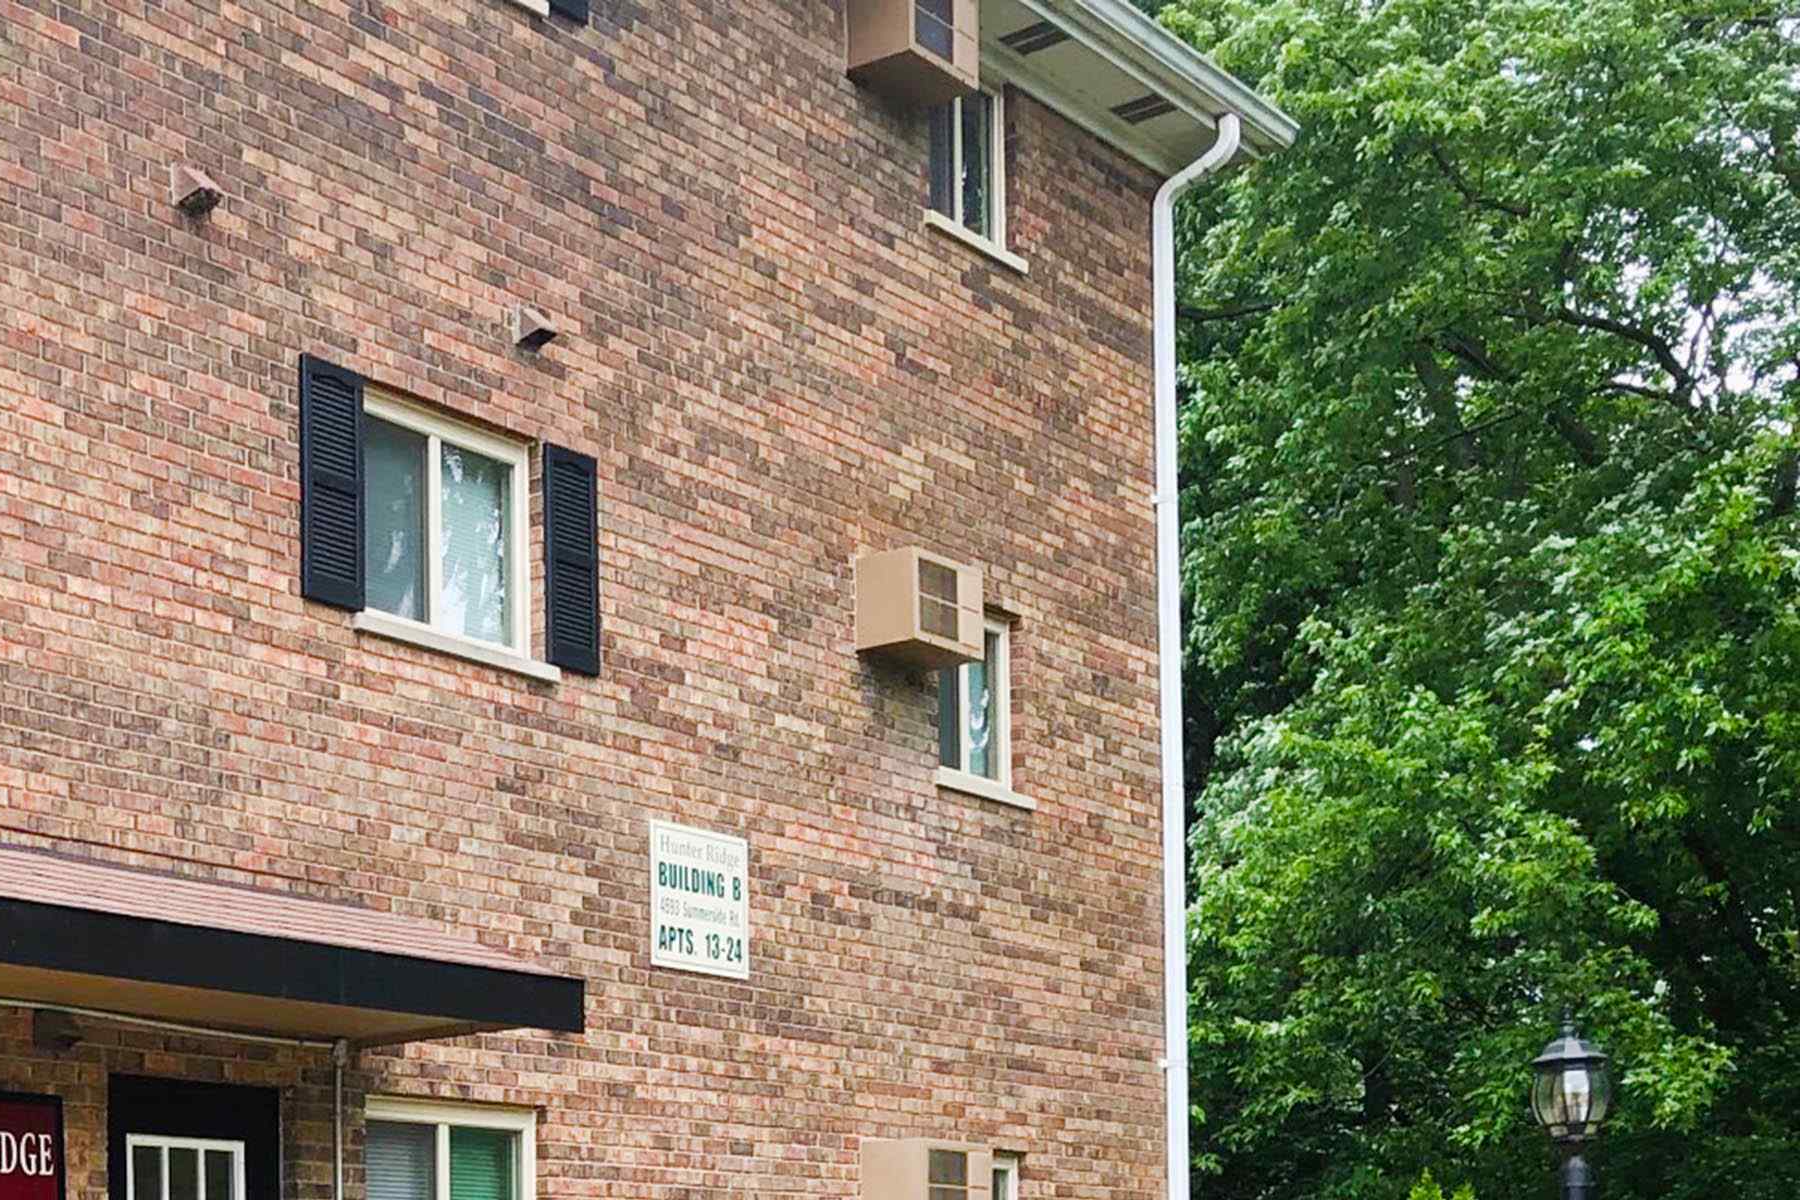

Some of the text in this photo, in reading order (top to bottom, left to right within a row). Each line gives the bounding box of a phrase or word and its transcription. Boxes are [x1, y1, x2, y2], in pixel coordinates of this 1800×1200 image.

[659, 833, 741, 873] Hunter Ridge
[658, 861, 742, 901] BUILDING B
[705, 933, 743, 964] 13-24
